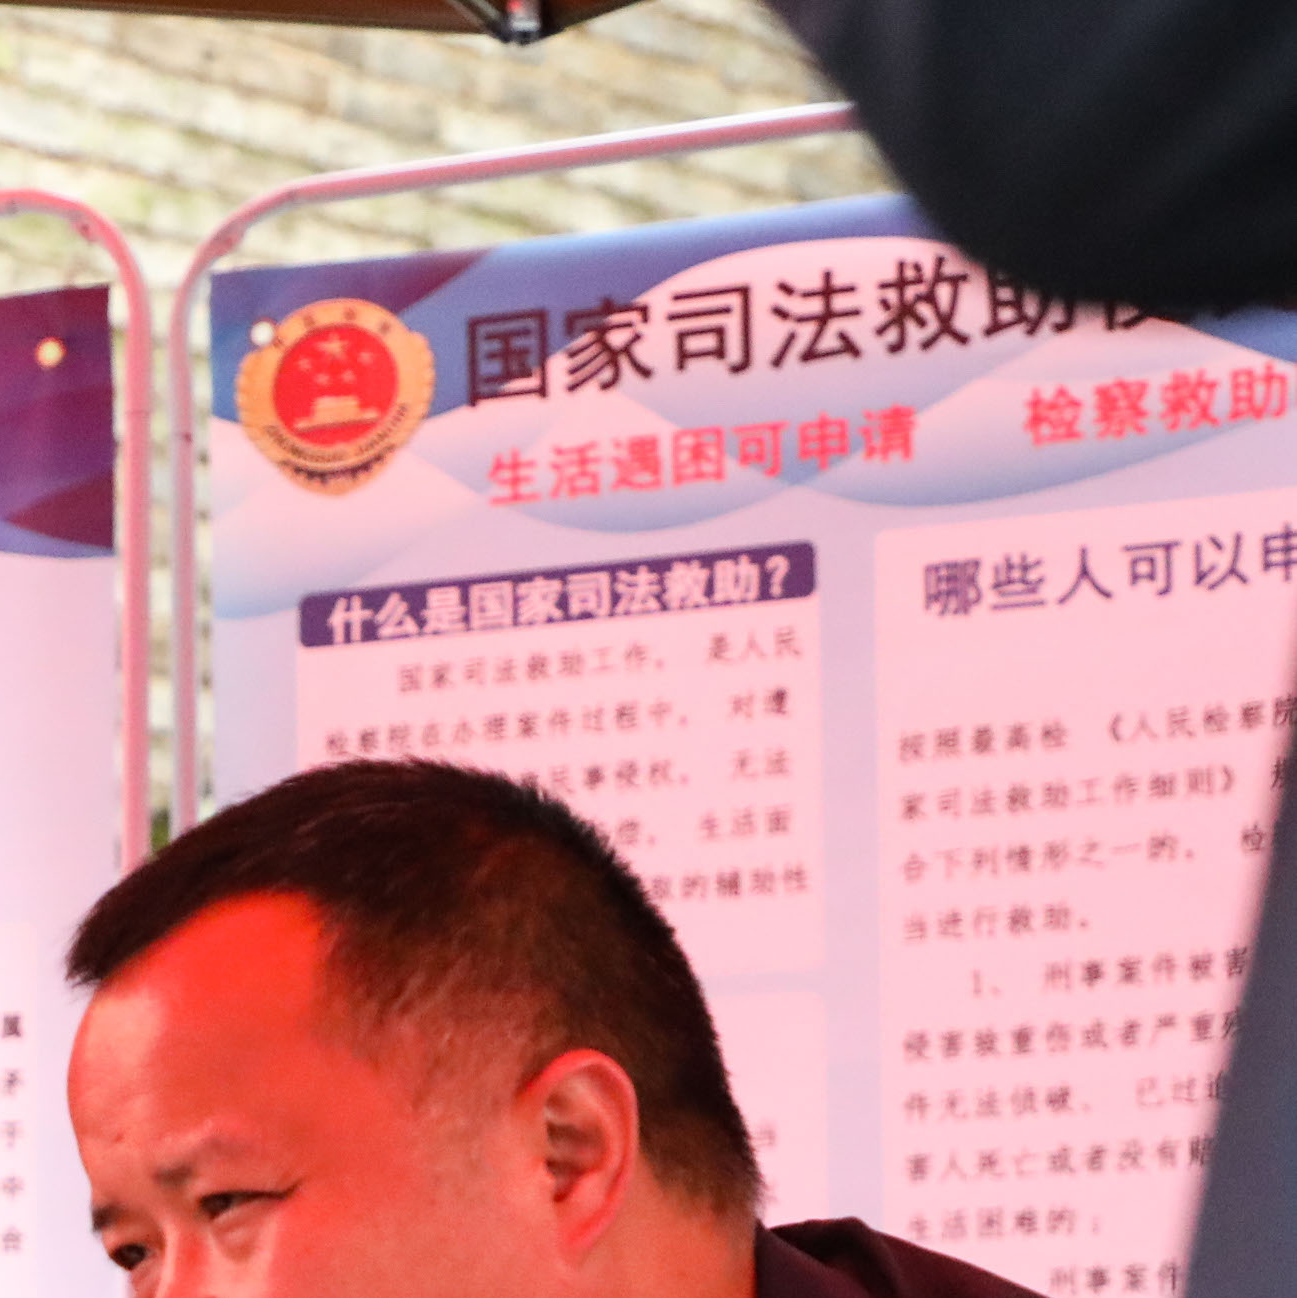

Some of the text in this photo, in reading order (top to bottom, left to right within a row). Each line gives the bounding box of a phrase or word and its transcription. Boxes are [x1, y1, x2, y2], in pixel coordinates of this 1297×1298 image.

[467, 256, 1151, 408] 国家司法救助
[488, 363, 1290, 504] 生活遇困可申请 检察救助
[327, 554, 792, 645] 什么是国家司法救助？
[923, 523, 1297, 616] 哪些人可以申
